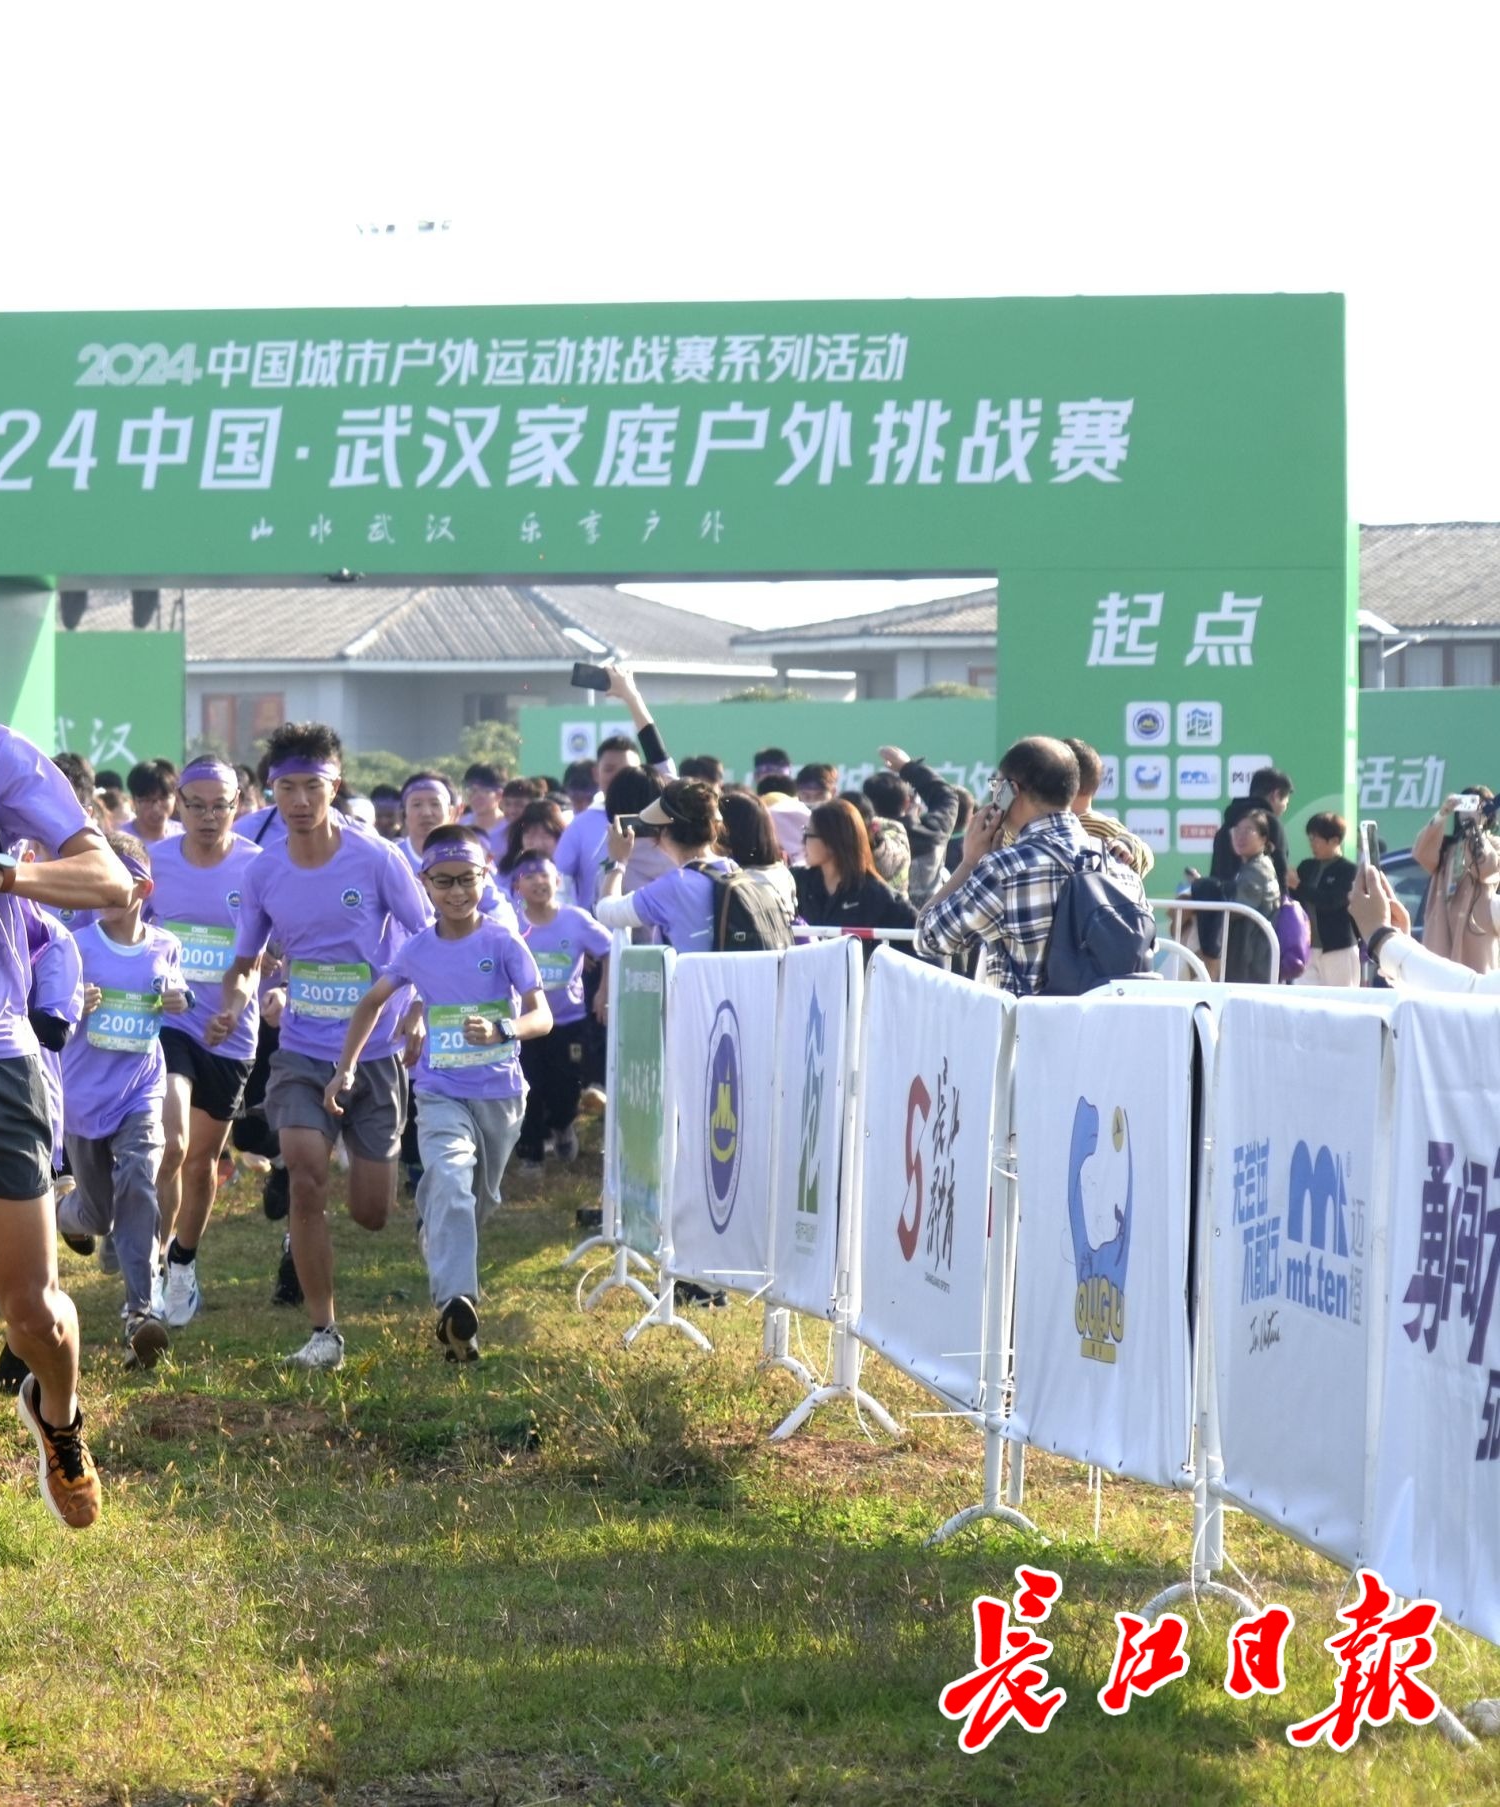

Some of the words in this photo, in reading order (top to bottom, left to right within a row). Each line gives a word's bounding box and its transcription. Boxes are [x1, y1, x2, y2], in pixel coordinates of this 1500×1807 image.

[73, 332, 909, 389] 2024中国城市户外运动挑战赛系列活动
[1085, 590, 1264, 667] 起点
[300, 983, 360, 1002] 20078
[99, 1013, 155, 1035] 20014
[1286, 1251, 1348, 1321] mt.ten
